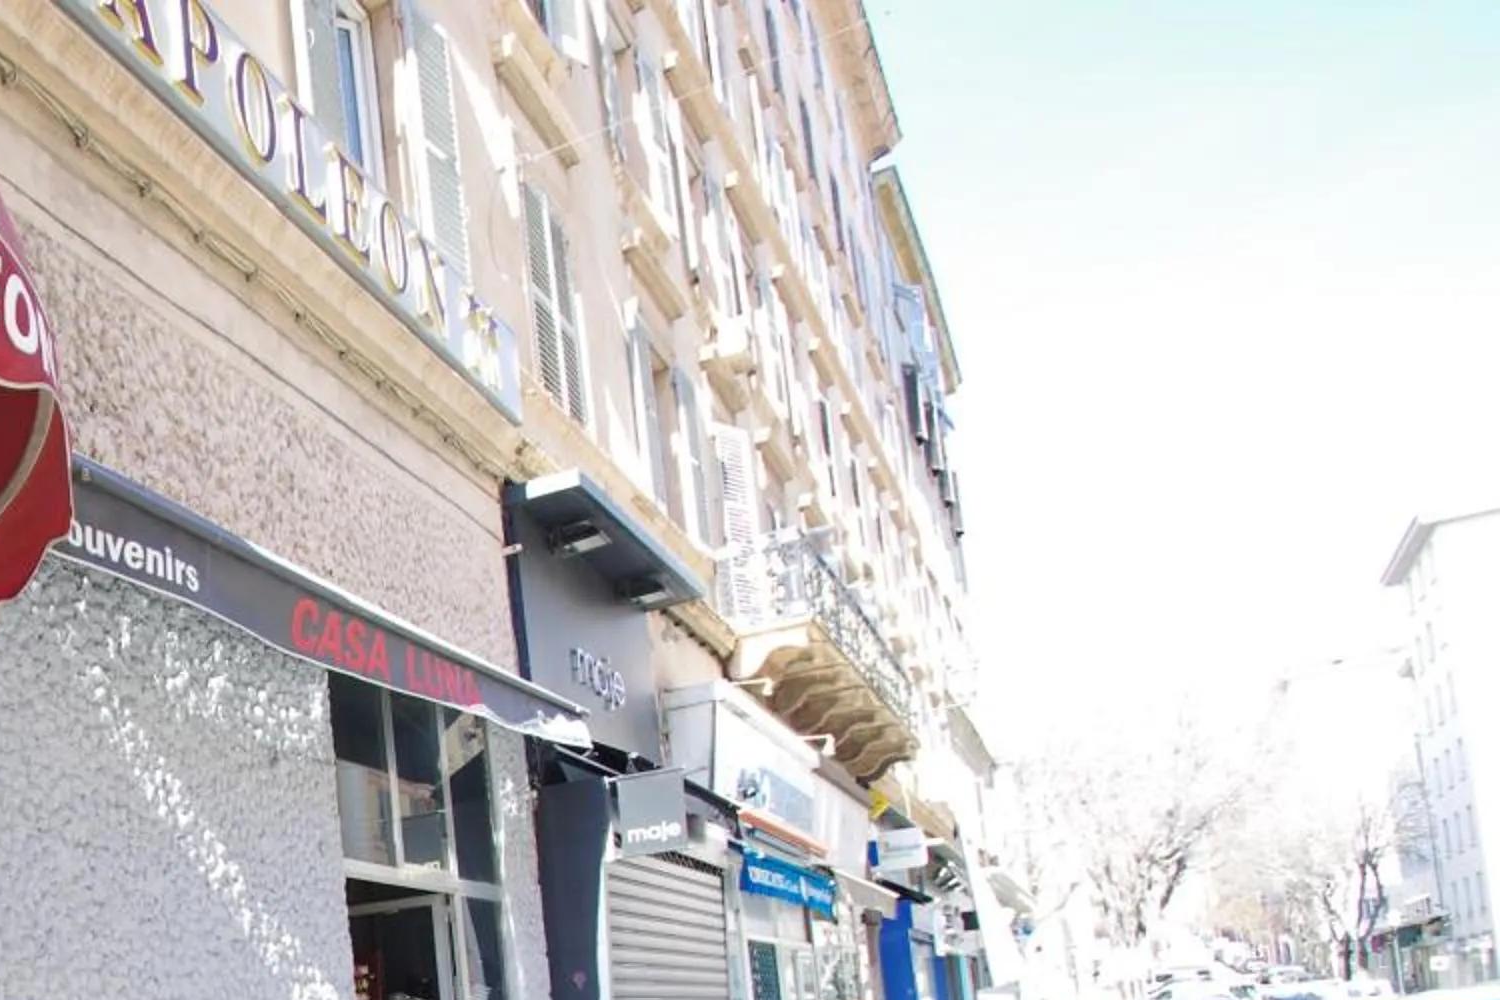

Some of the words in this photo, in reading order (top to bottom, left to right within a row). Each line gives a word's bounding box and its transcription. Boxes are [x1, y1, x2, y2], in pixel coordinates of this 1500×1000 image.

[67, 518, 201, 594] ouvenirs
[290, 597, 391, 686] CASA
[405, 642, 484, 706] LUNA
